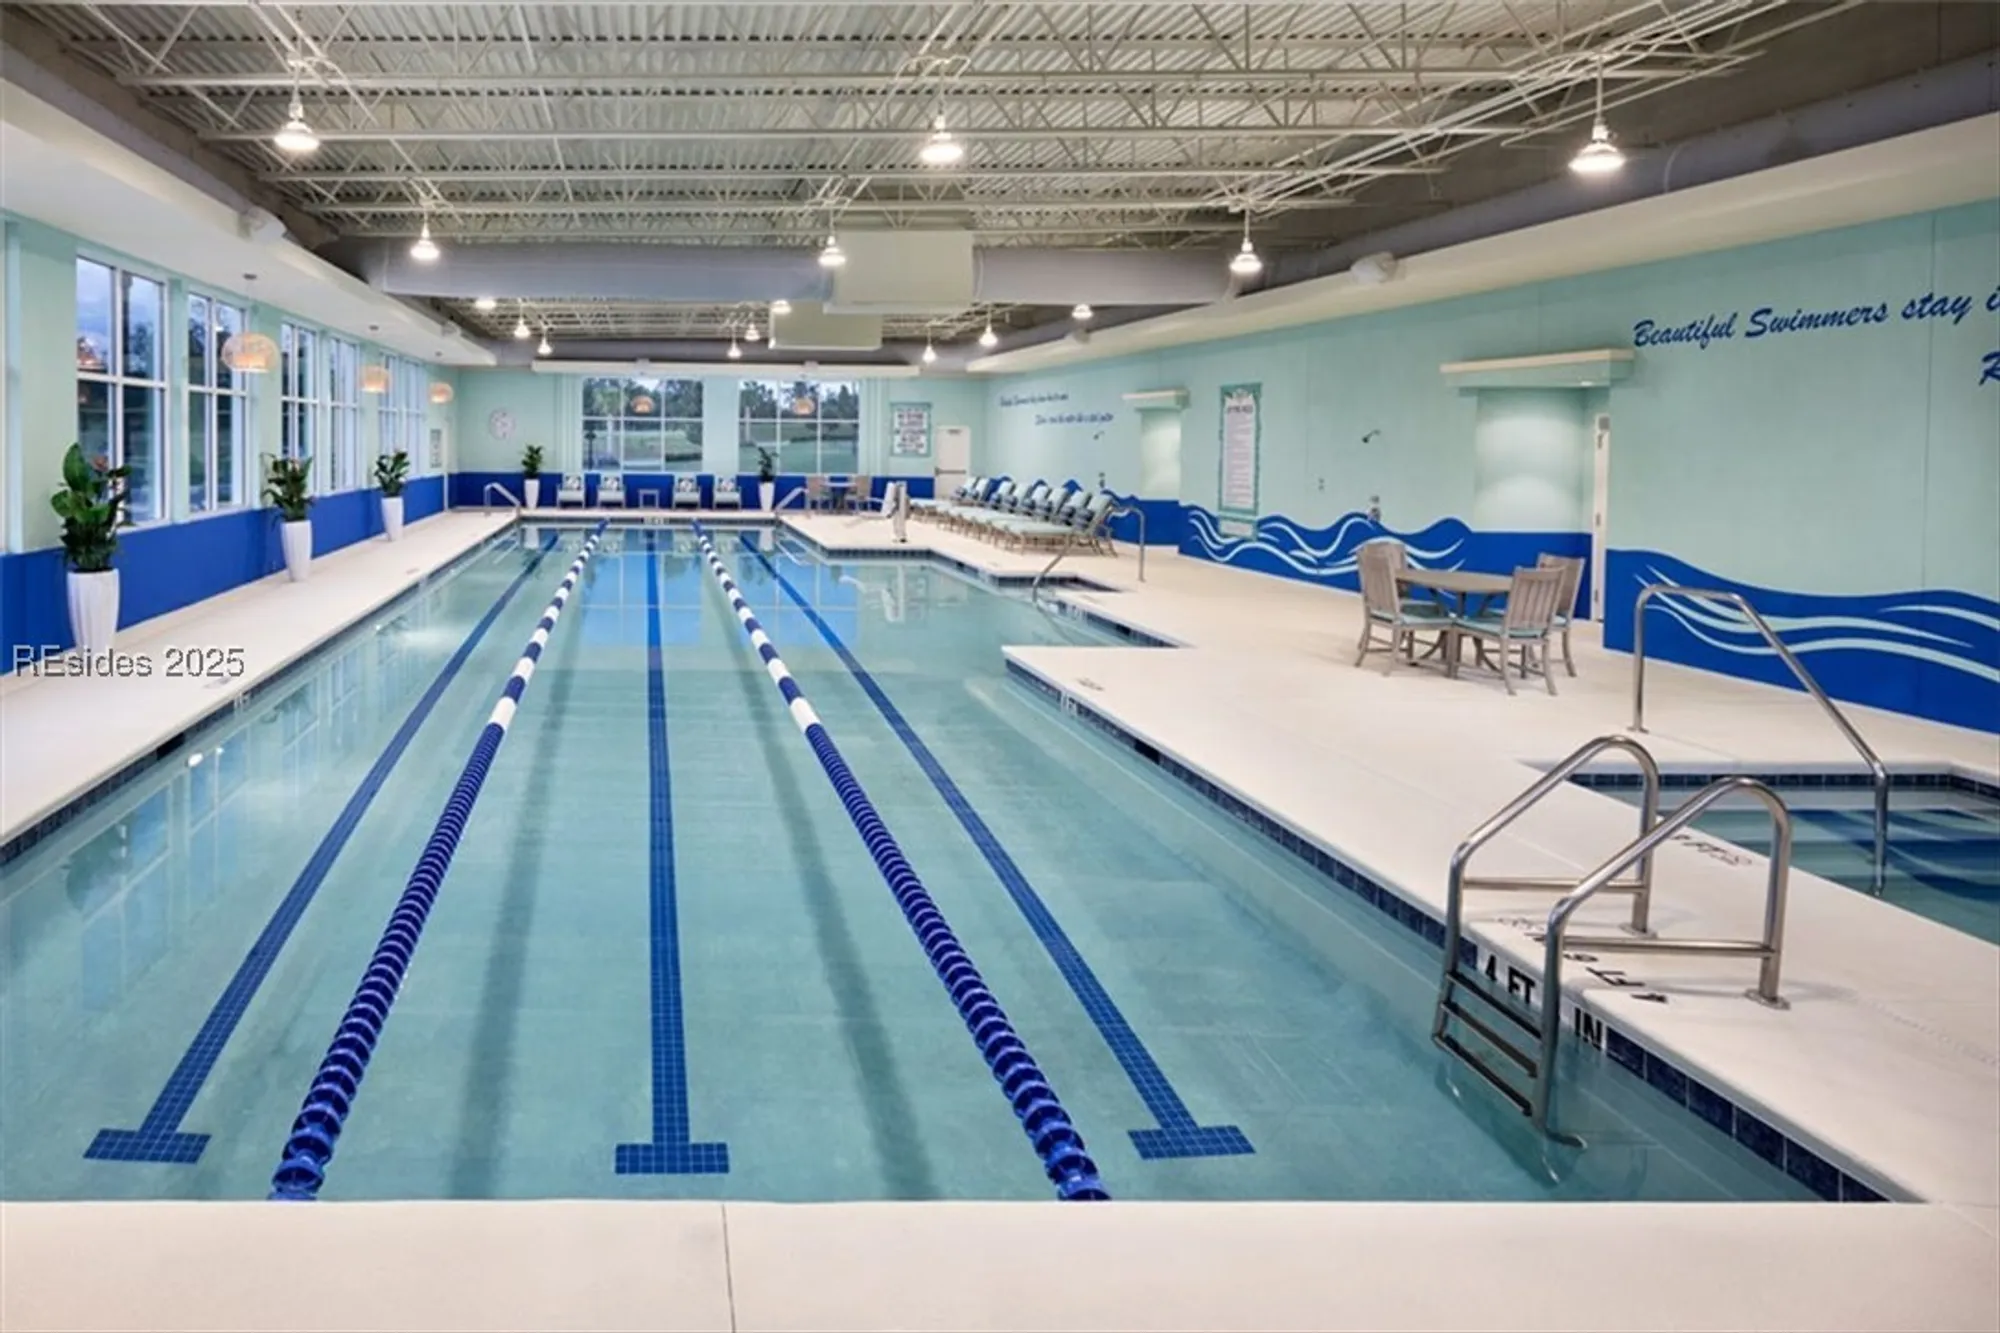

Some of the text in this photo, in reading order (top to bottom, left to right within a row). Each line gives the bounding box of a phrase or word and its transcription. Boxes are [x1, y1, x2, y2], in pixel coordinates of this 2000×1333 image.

[1633, 312, 1738, 349] Beautiful
[1745, 303, 1889, 338] Swimmers
[1901, 292, 1972, 325] stay
[1484, 953, 1603, 1051] 4 FT IN
